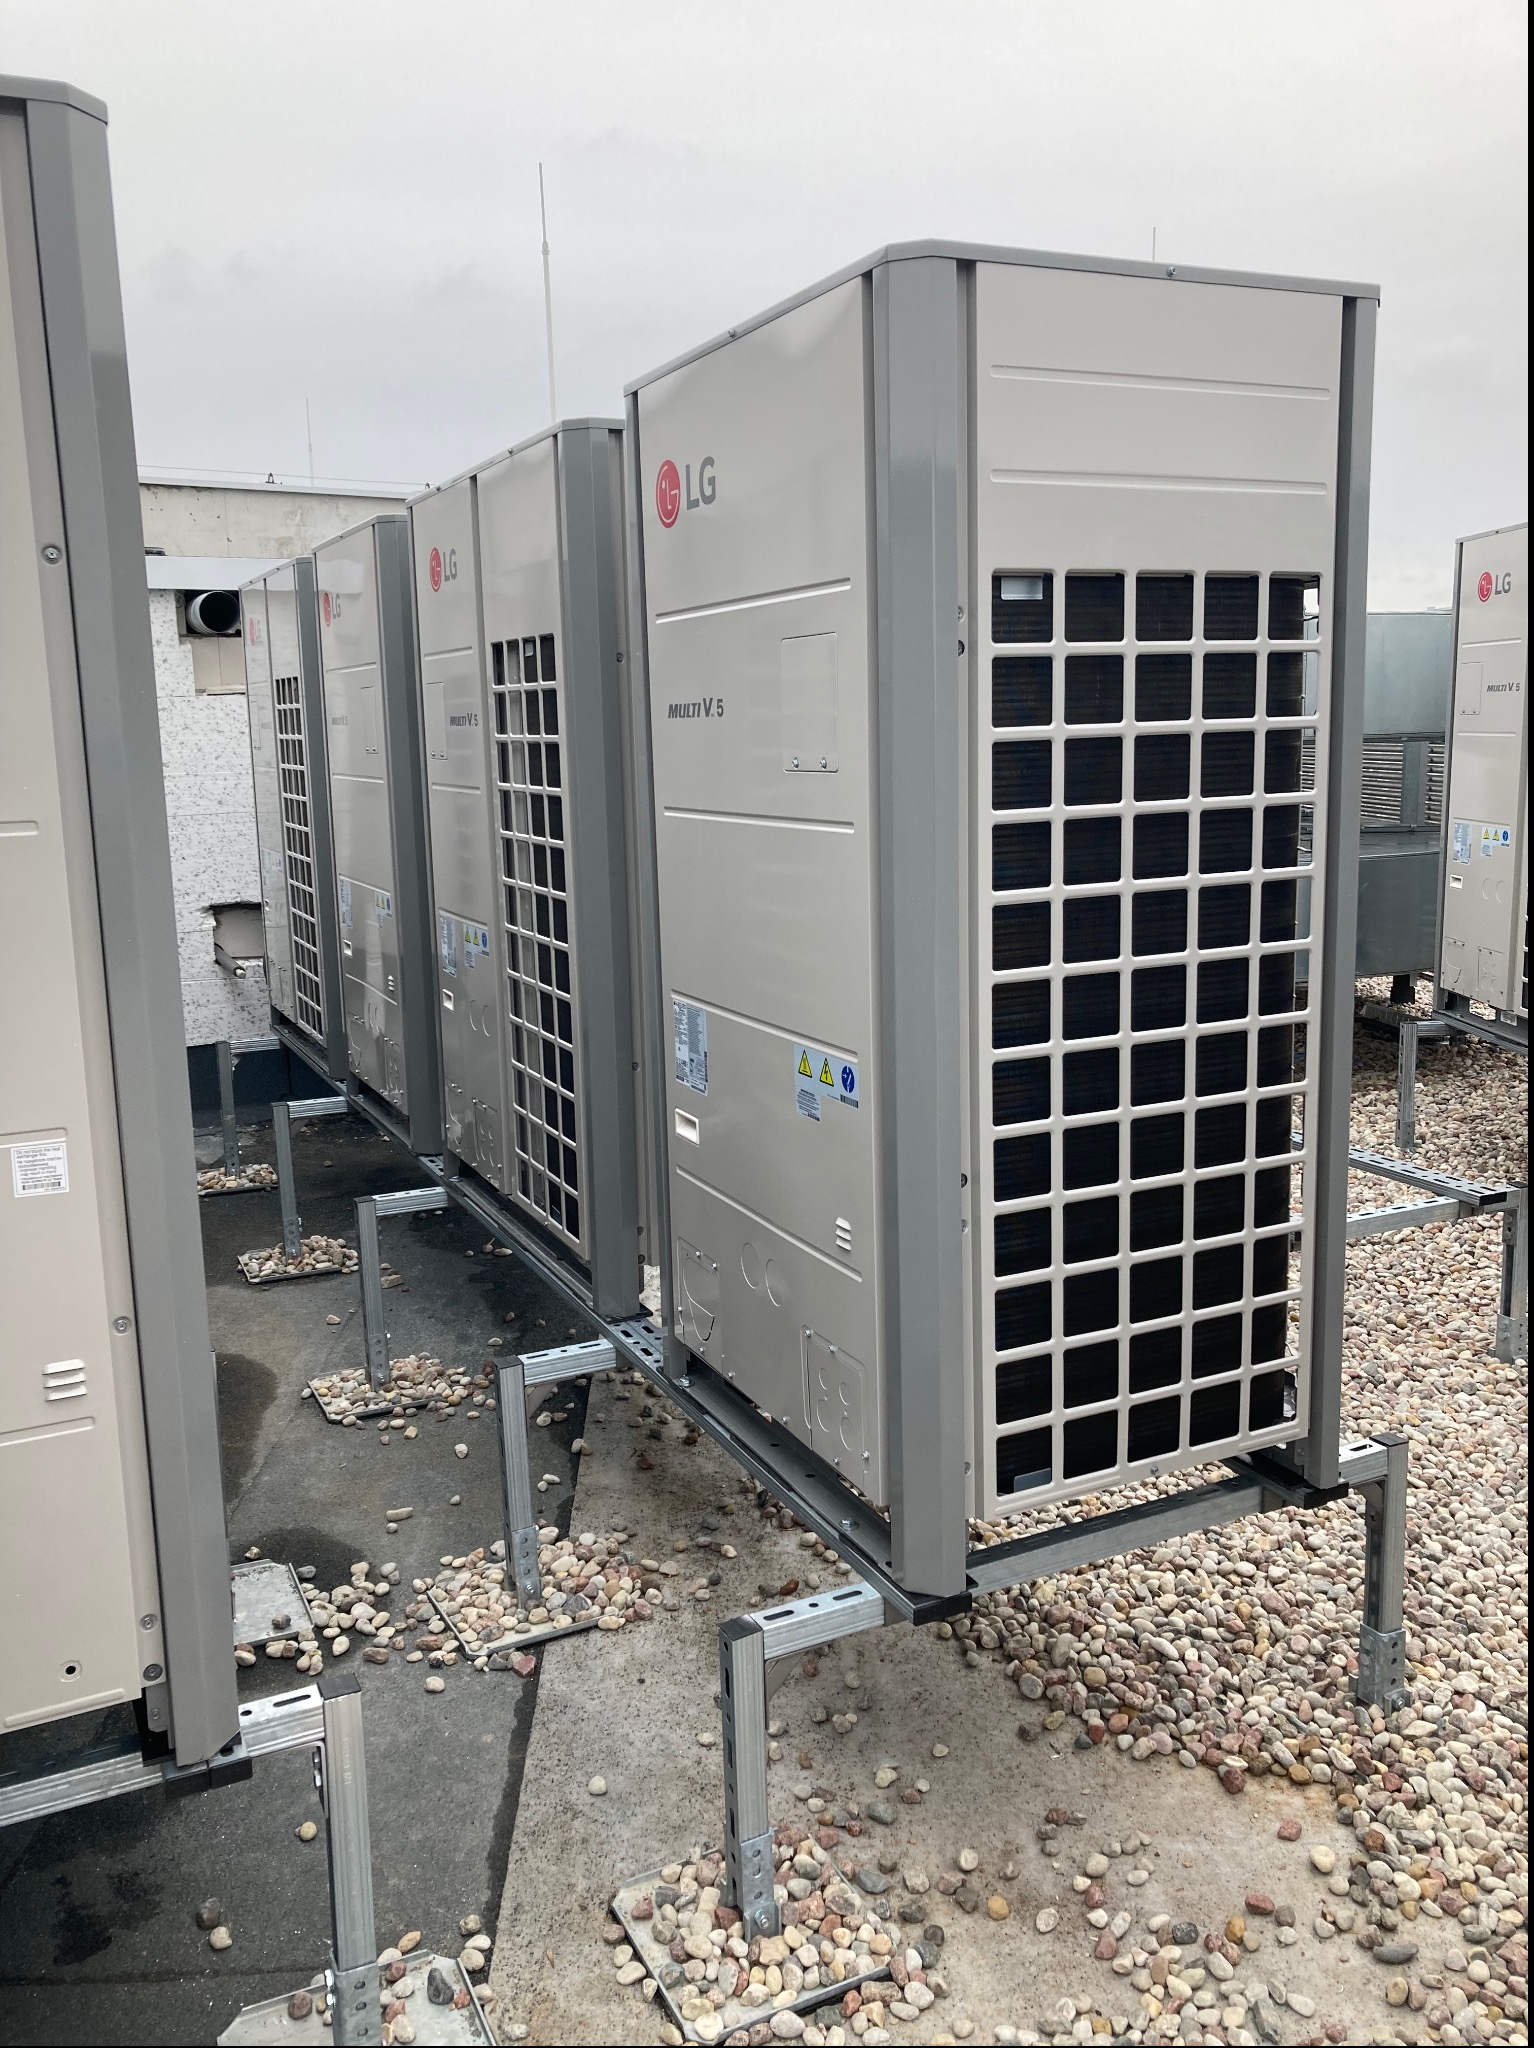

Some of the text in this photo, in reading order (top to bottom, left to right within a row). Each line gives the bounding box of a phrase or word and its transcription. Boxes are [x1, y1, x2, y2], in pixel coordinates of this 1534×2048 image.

[685, 456, 716, 511] LG
[443, 548, 457, 582] LG
[1494, 572, 1511, 595] LG
[331, 593, 341, 619] LG
[1486, 684, 1507, 692] MULTI
[668, 702, 701, 719] MULTI
